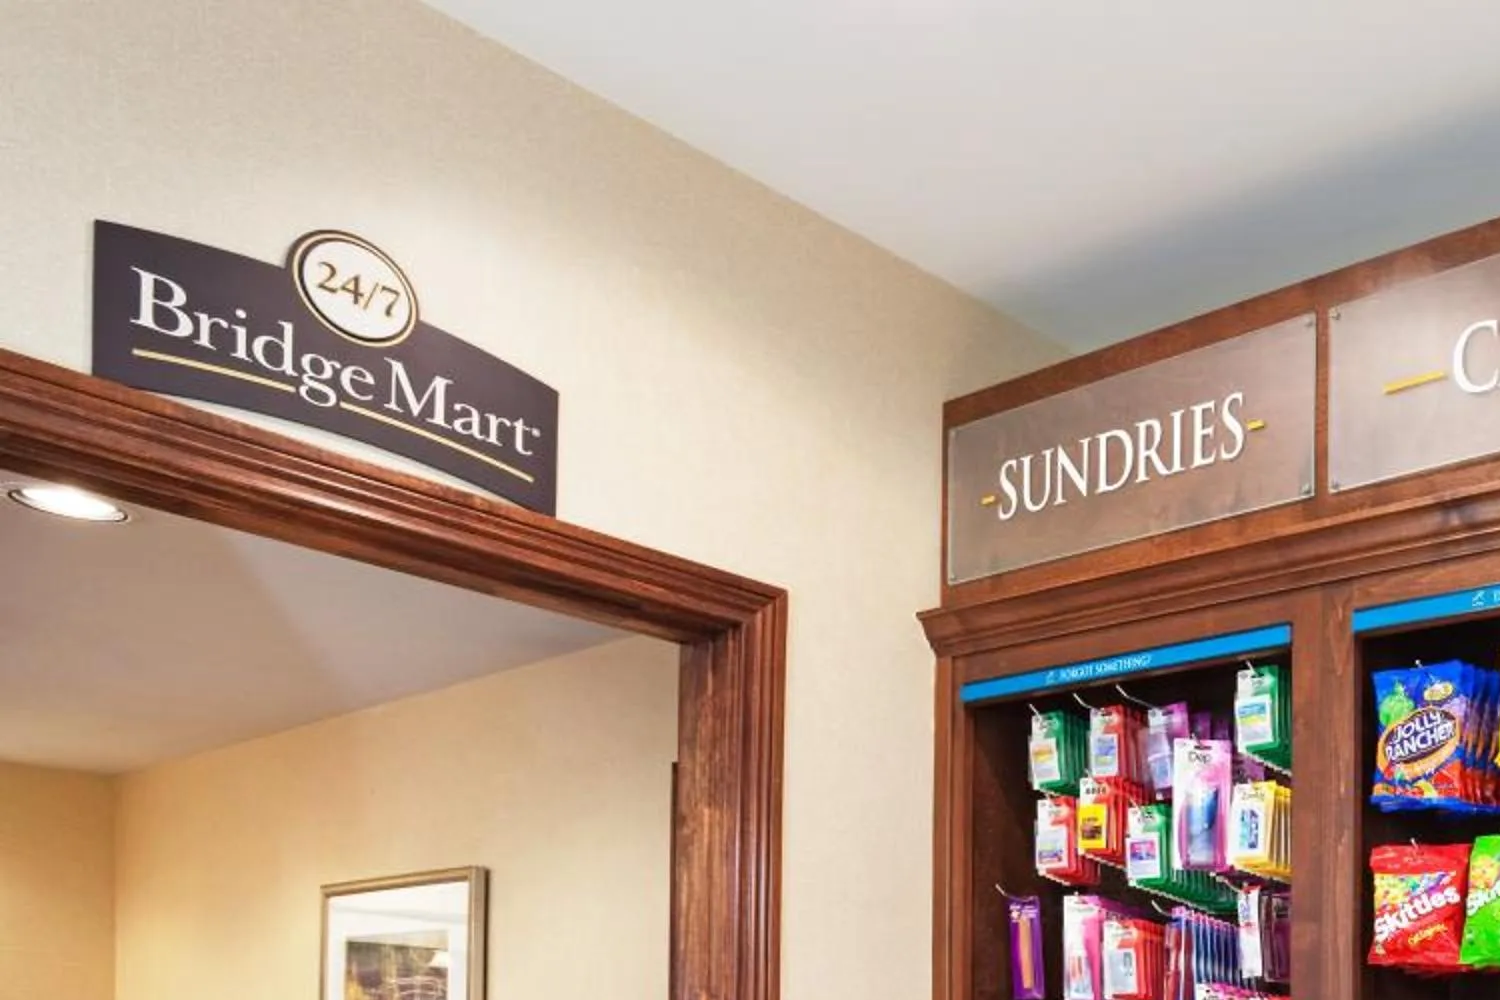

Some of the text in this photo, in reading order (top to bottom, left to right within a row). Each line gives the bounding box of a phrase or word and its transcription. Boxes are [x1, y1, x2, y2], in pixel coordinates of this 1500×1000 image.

[310, 260, 402, 318] 24/7
[130, 265, 375, 407] Bridge
[997, 391, 1244, 521] SUNDRIES
[1385, 723, 1456, 763] RANCHER
[1393, 710, 1442, 744] JOLLY
